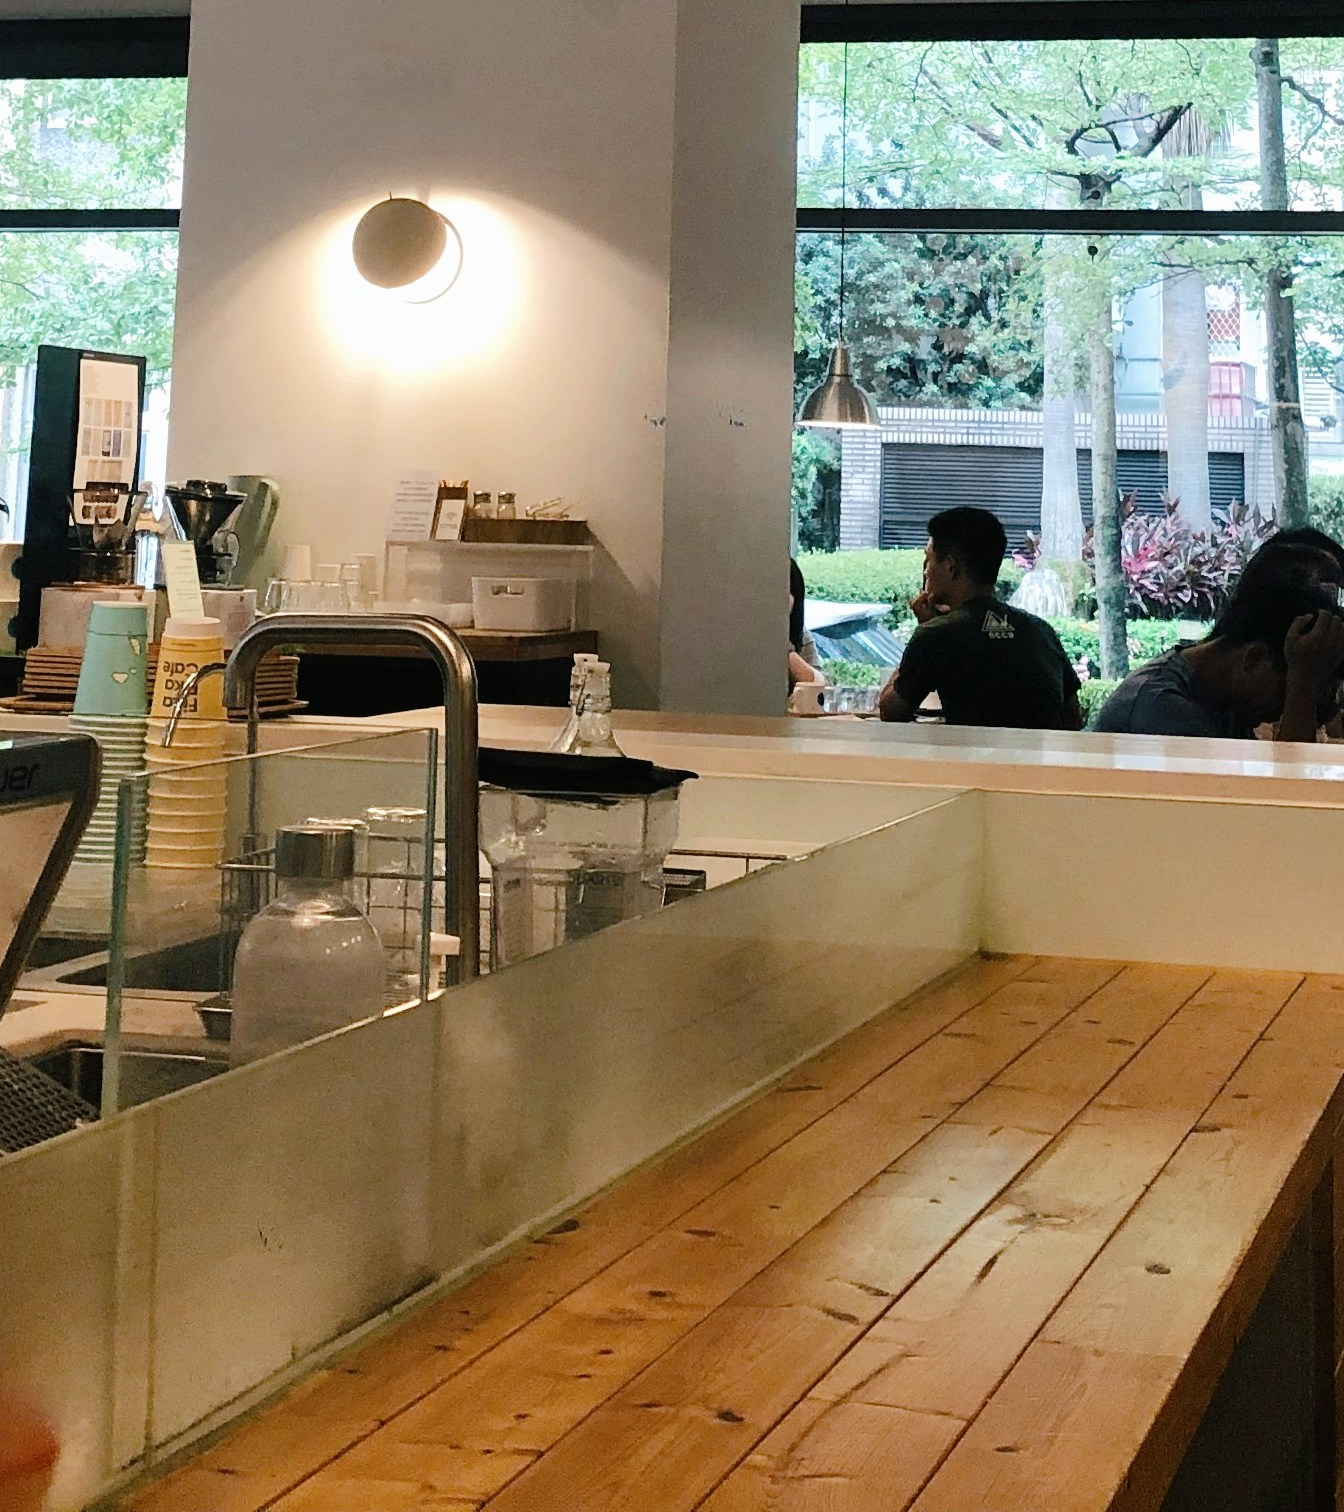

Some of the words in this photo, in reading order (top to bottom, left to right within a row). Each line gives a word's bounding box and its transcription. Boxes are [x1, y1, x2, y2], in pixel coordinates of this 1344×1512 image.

[163, 661, 198, 677] Cafe
[164, 679, 197, 696] Fka
[163, 696, 197, 713] Fia
